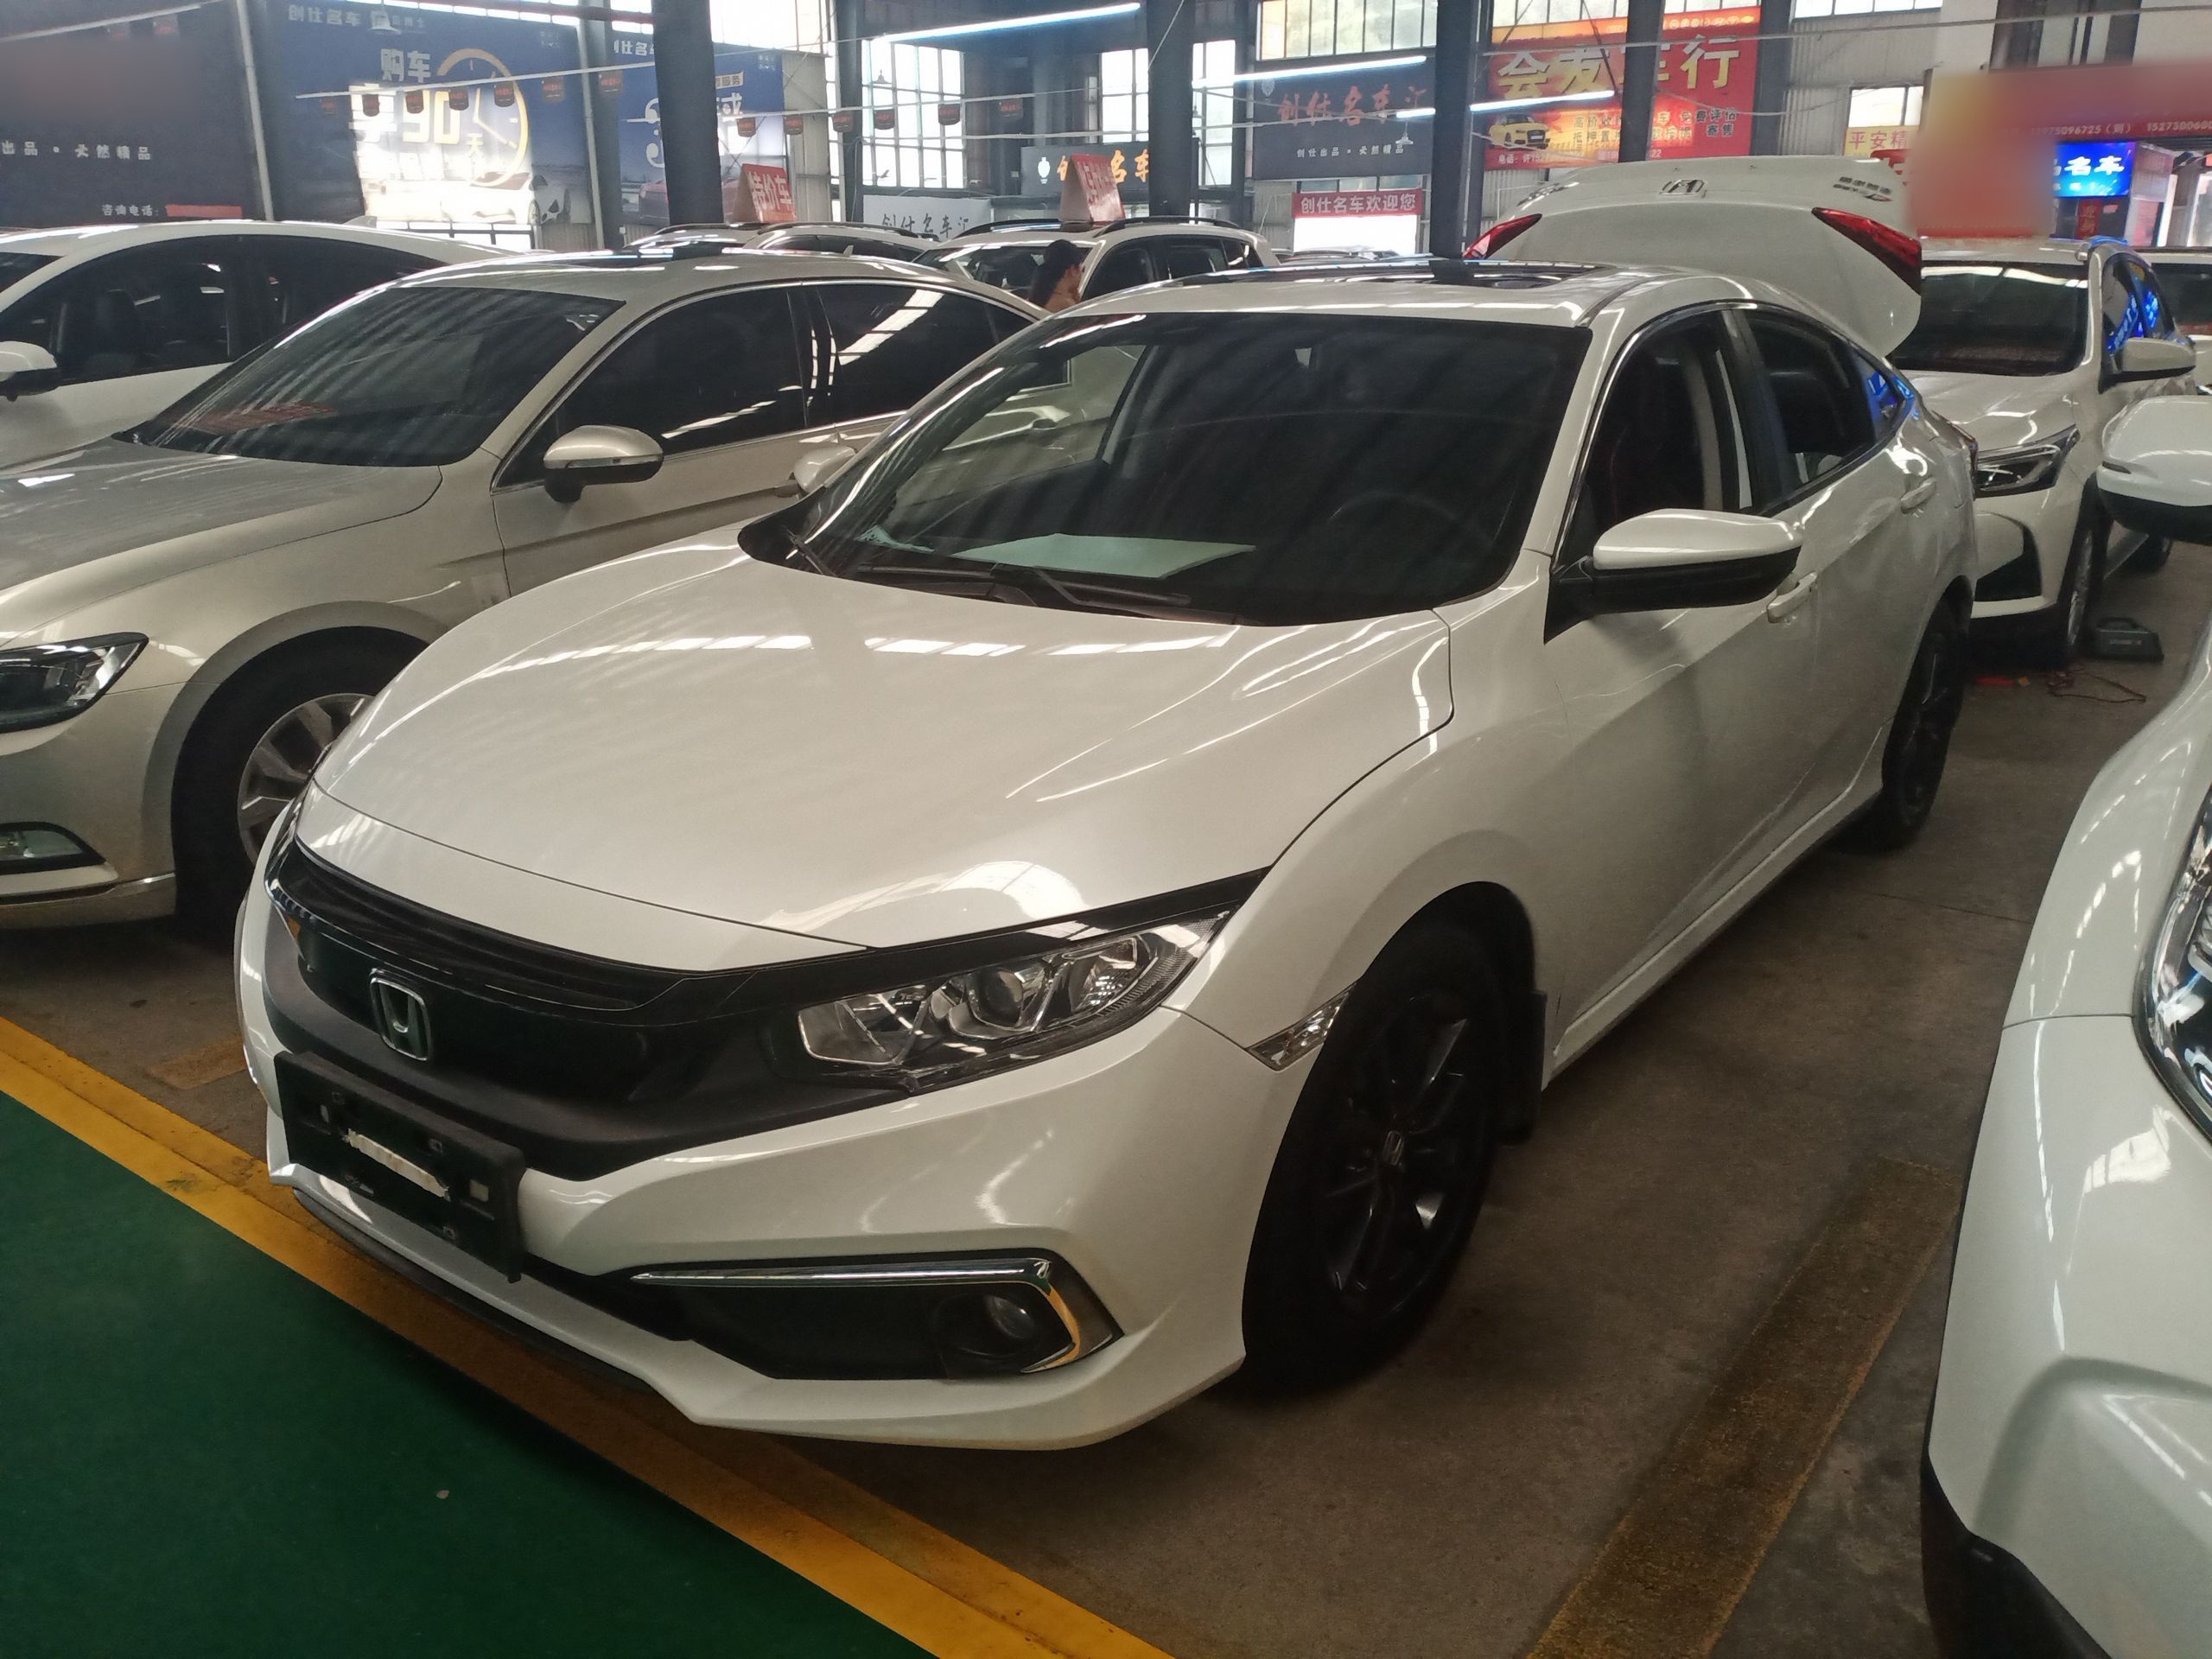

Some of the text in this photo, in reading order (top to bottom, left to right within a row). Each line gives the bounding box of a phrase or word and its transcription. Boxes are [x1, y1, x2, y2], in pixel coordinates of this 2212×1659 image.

[380, 48, 431, 84] 购车
[2053, 156, 2125, 176] 名车
[1300, 193, 1416, 214] 创仕名车欢迎您
